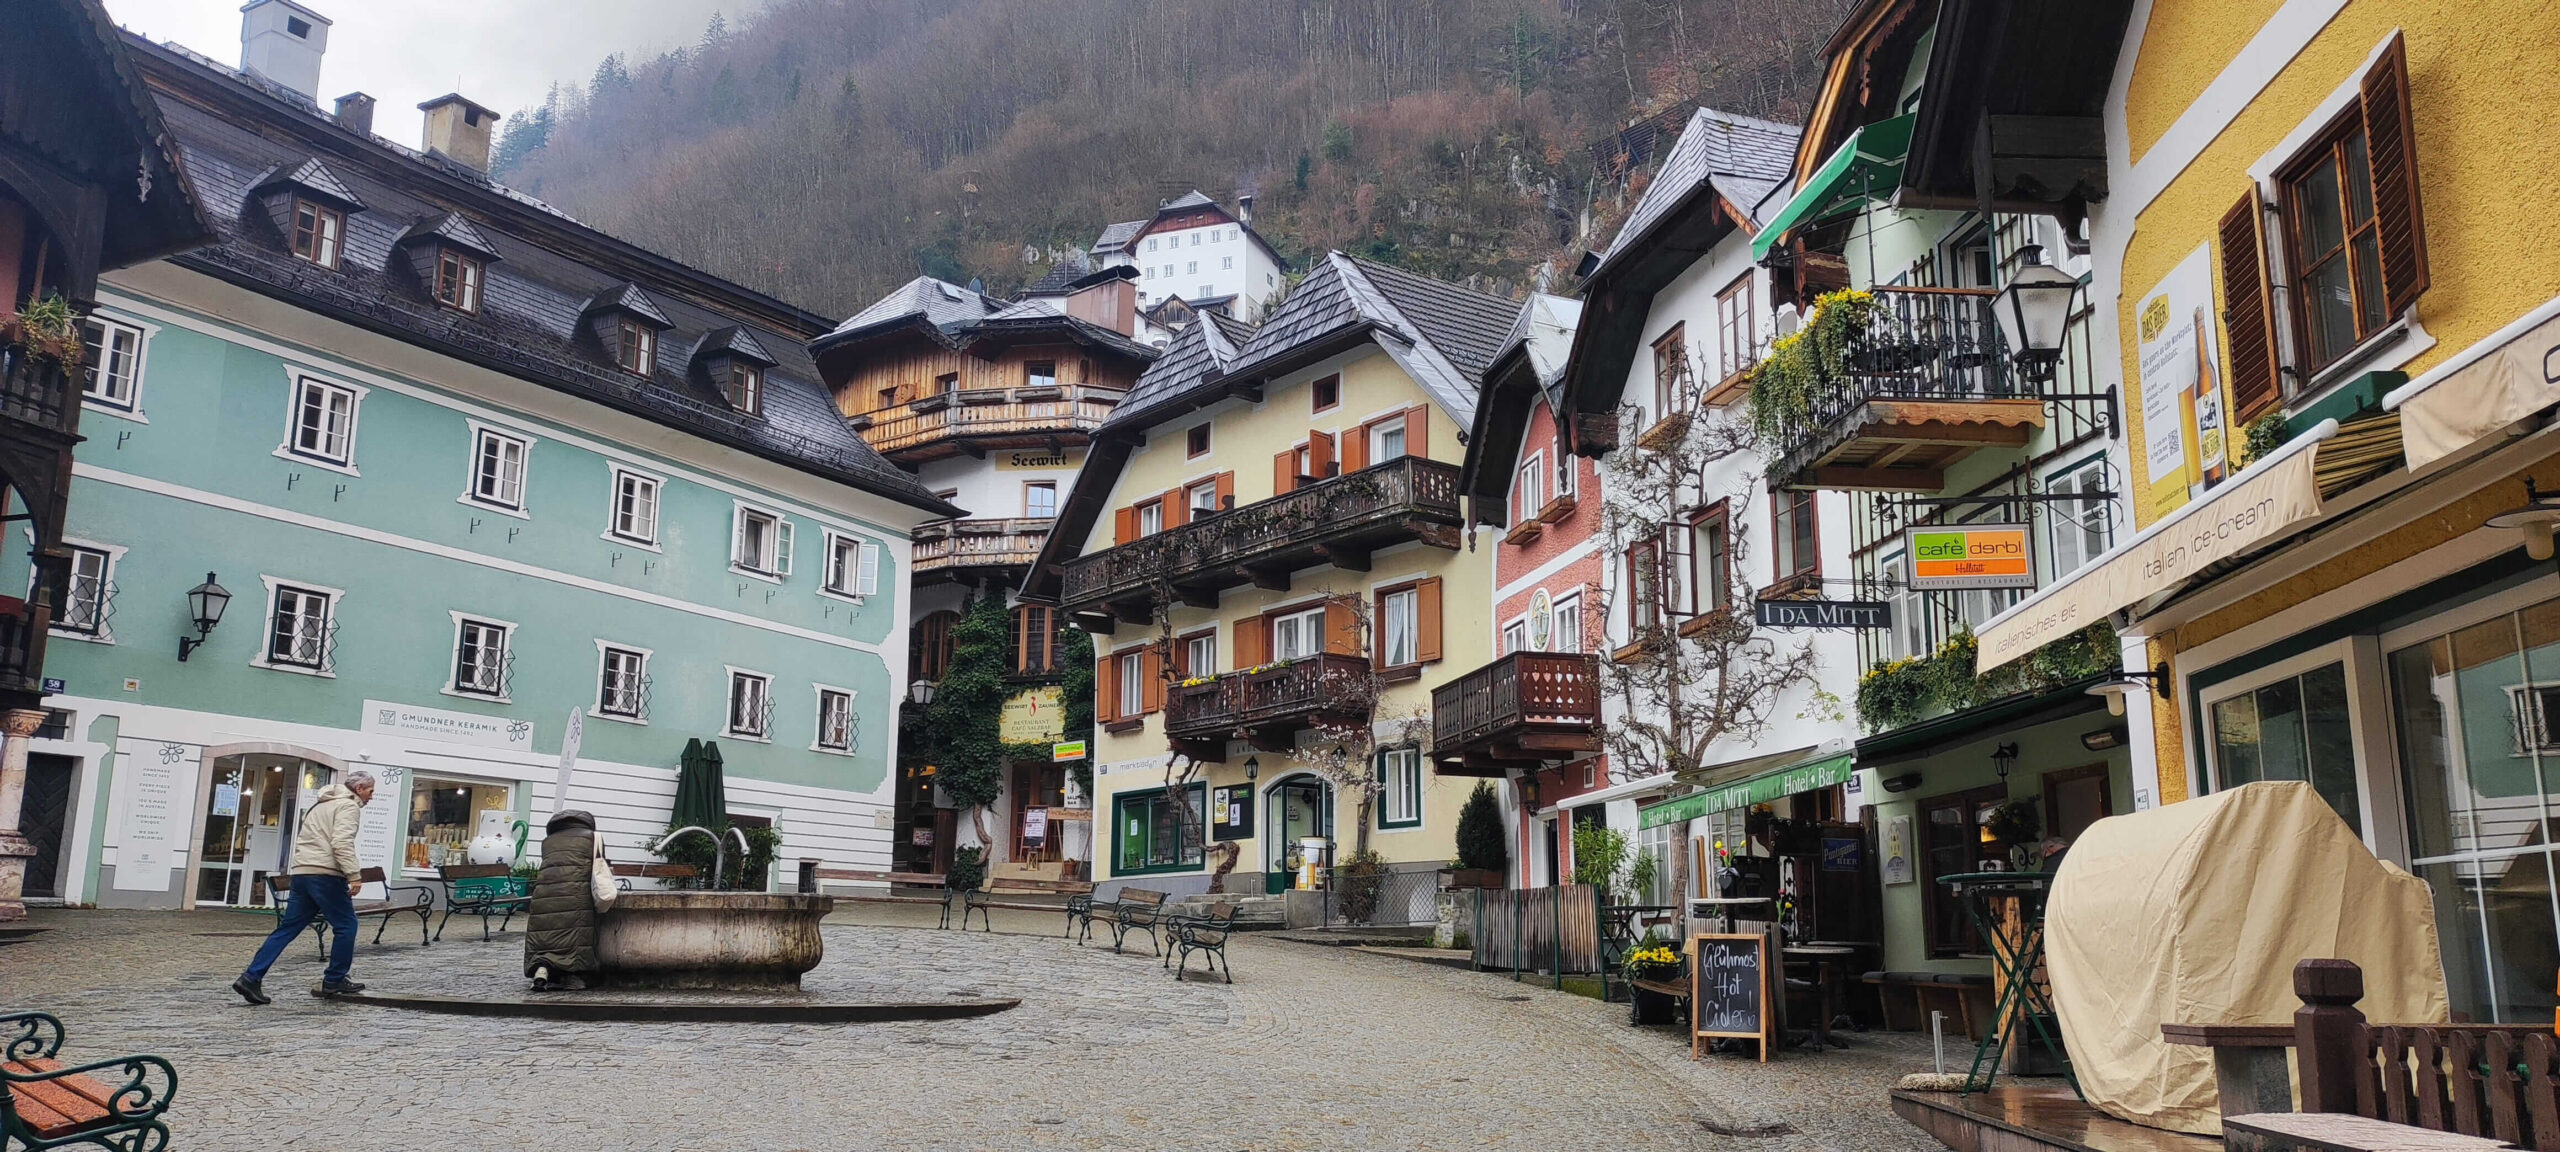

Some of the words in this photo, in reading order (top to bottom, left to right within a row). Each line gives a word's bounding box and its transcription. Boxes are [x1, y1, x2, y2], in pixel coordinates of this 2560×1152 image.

[2141, 315, 2153, 339] DAS
[1011, 453, 1067, 466] Seewirt
[1970, 540, 2022, 555] derbl
[2143, 546, 2186, 580] italian
[2190, 498, 2275, 555] ice-cream
[1955, 562, 1987, 574] Hallstatt
[1978, 577, 2030, 585] RESTAURANT
[1764, 603, 1810, 625] IDA
[1817, 604, 1880, 626] MITT
[1994, 614, 2057, 655] italienisches
[2061, 602, 2077, 623] eis
[48, 679, 60, 688] 58
[401, 723, 437, 732] HANDMADE
[439, 727, 459, 735] SINCE
[402, 713, 455, 727] GMUNDNER
[458, 721, 498, 733] KERAMIK
[1783, 775, 1810, 796] Hotel
[1817, 768, 1836, 787] Bar
[1705, 793, 1722, 814] IDA
[1724, 788, 1751, 811] MITT
[1648, 809, 1664, 826] Hotel
[1670, 808, 1682, 823] Bar
[1837, 857, 1857, 865] BIER
[1703, 942, 1759, 980] Glühmost
[1713, 972, 1743, 1001] Hot
